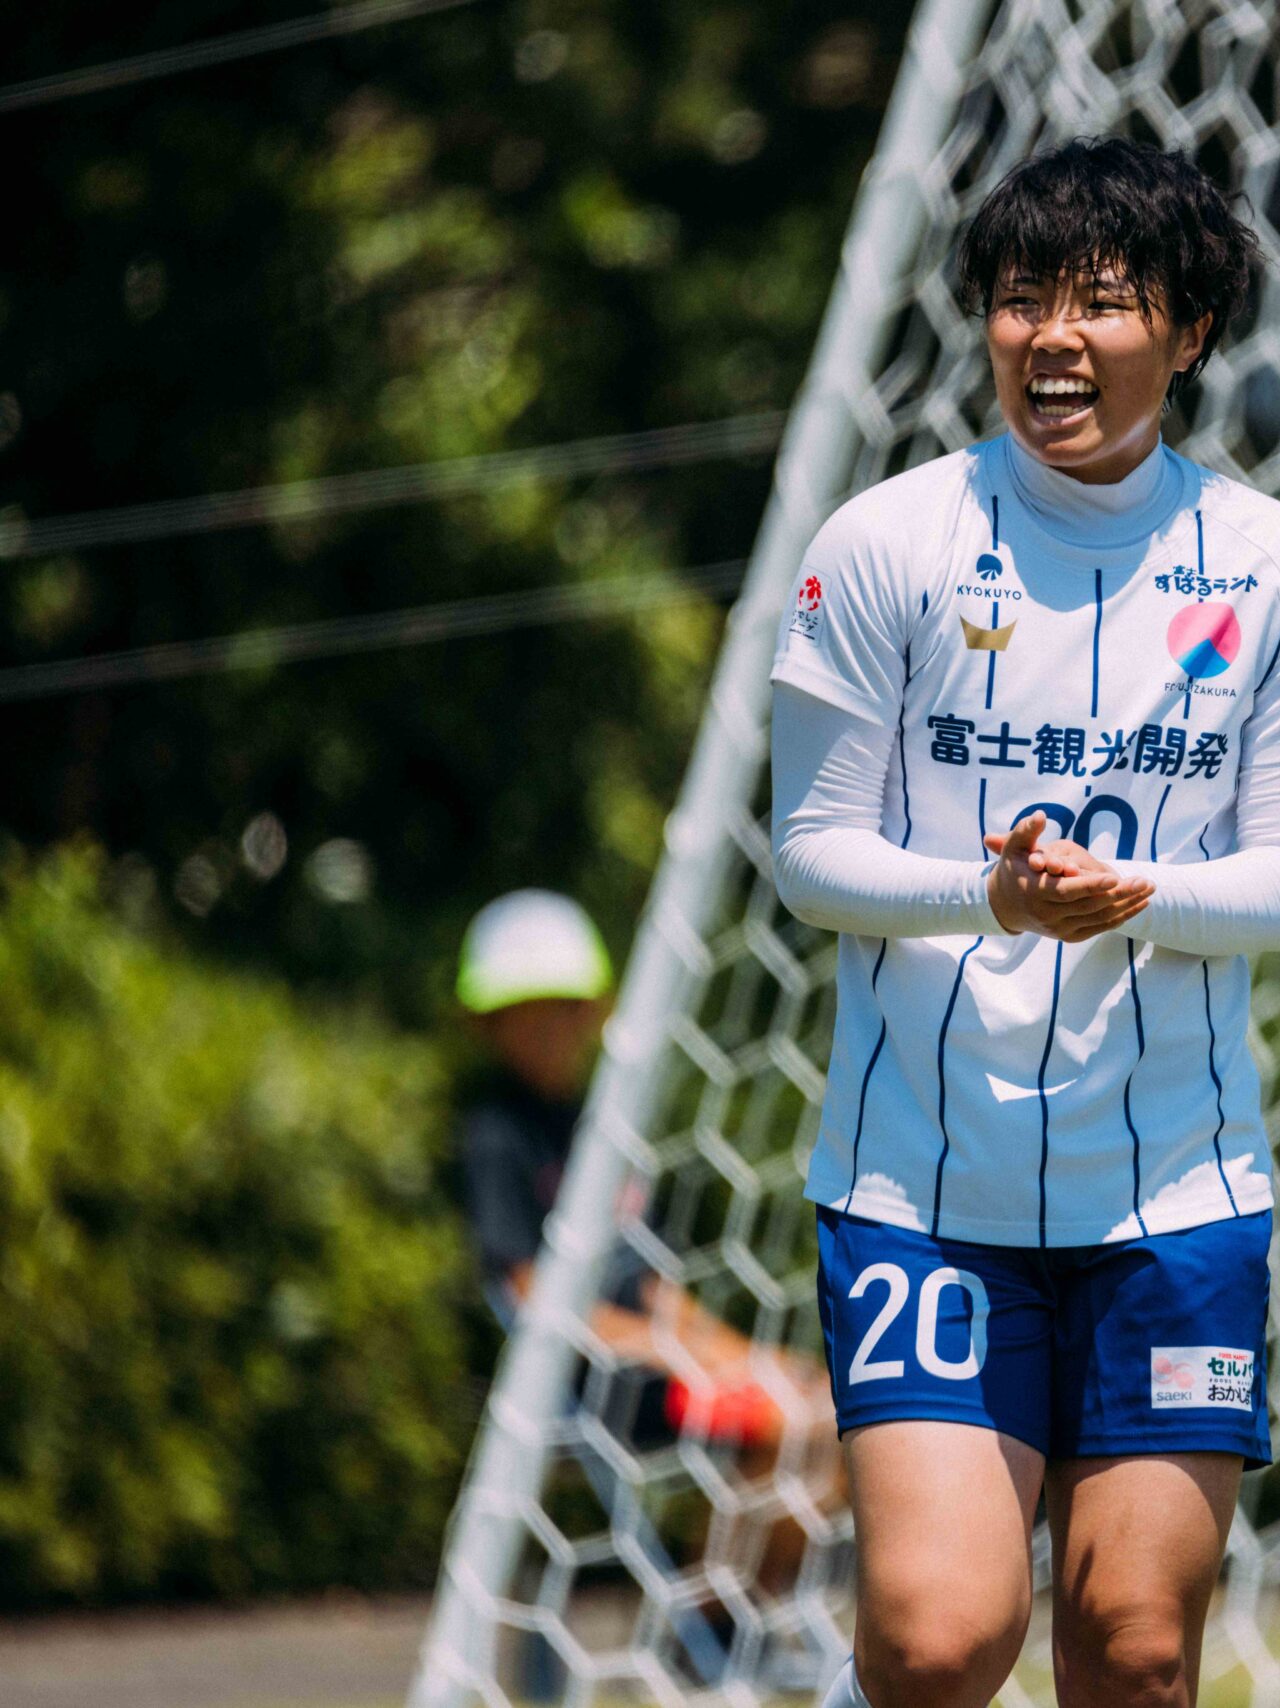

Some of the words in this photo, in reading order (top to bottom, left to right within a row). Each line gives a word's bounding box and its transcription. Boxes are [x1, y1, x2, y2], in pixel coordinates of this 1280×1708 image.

[956, 584, 1022, 600] KYOKUYO
[927, 713, 1228, 780] 富士観光開発
[848, 1262, 990, 1386] 20
